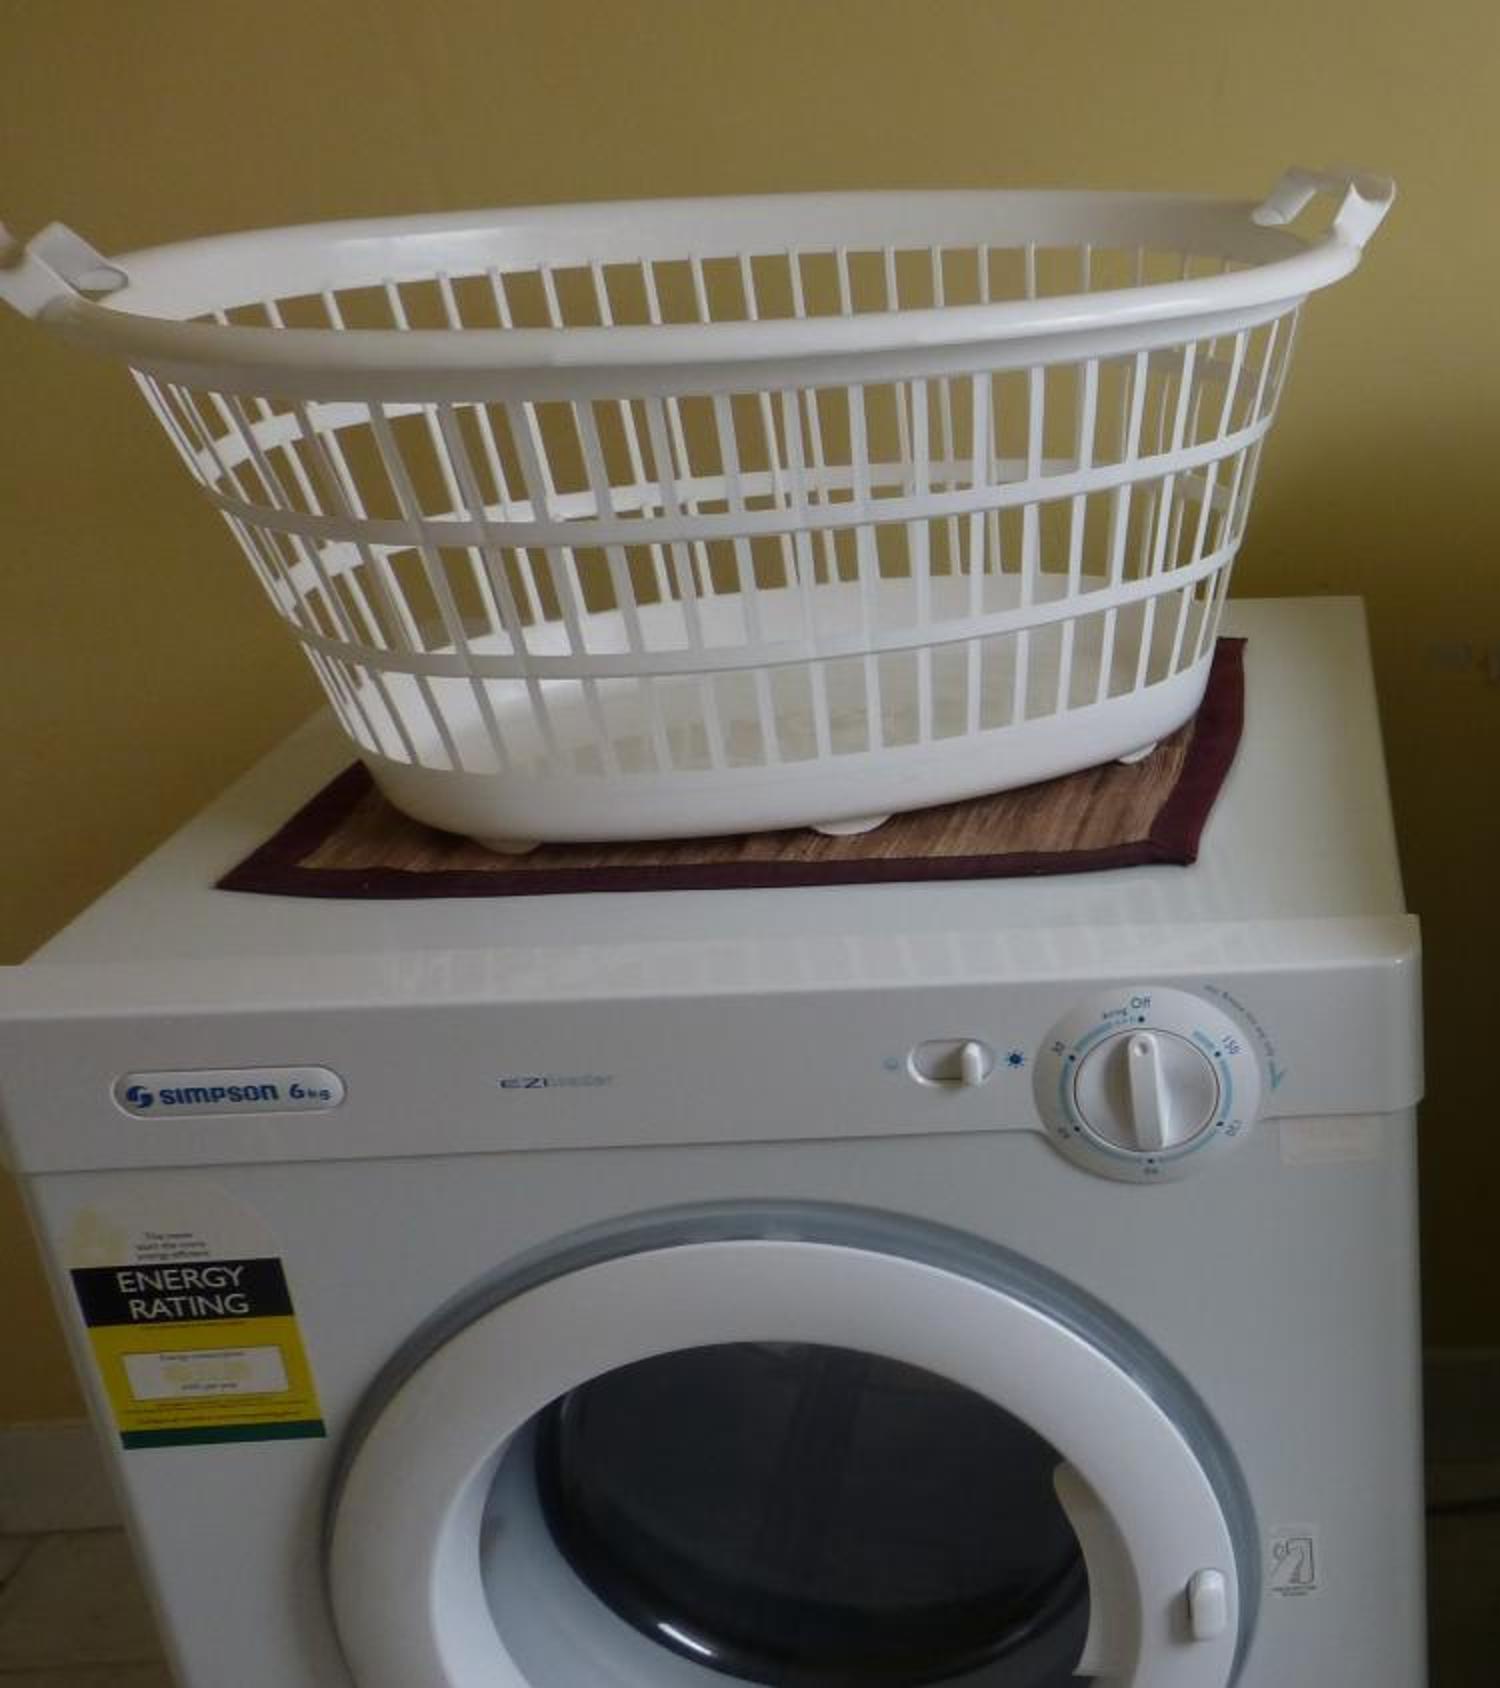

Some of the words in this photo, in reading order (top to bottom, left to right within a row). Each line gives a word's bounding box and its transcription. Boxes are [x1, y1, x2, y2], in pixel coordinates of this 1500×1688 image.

[1130, 996, 1152, 1009] Off
[159, 1084, 279, 1105] SIMPSON
[116, 1266, 246, 1294] ENERGY
[129, 1294, 249, 1320] RATING
